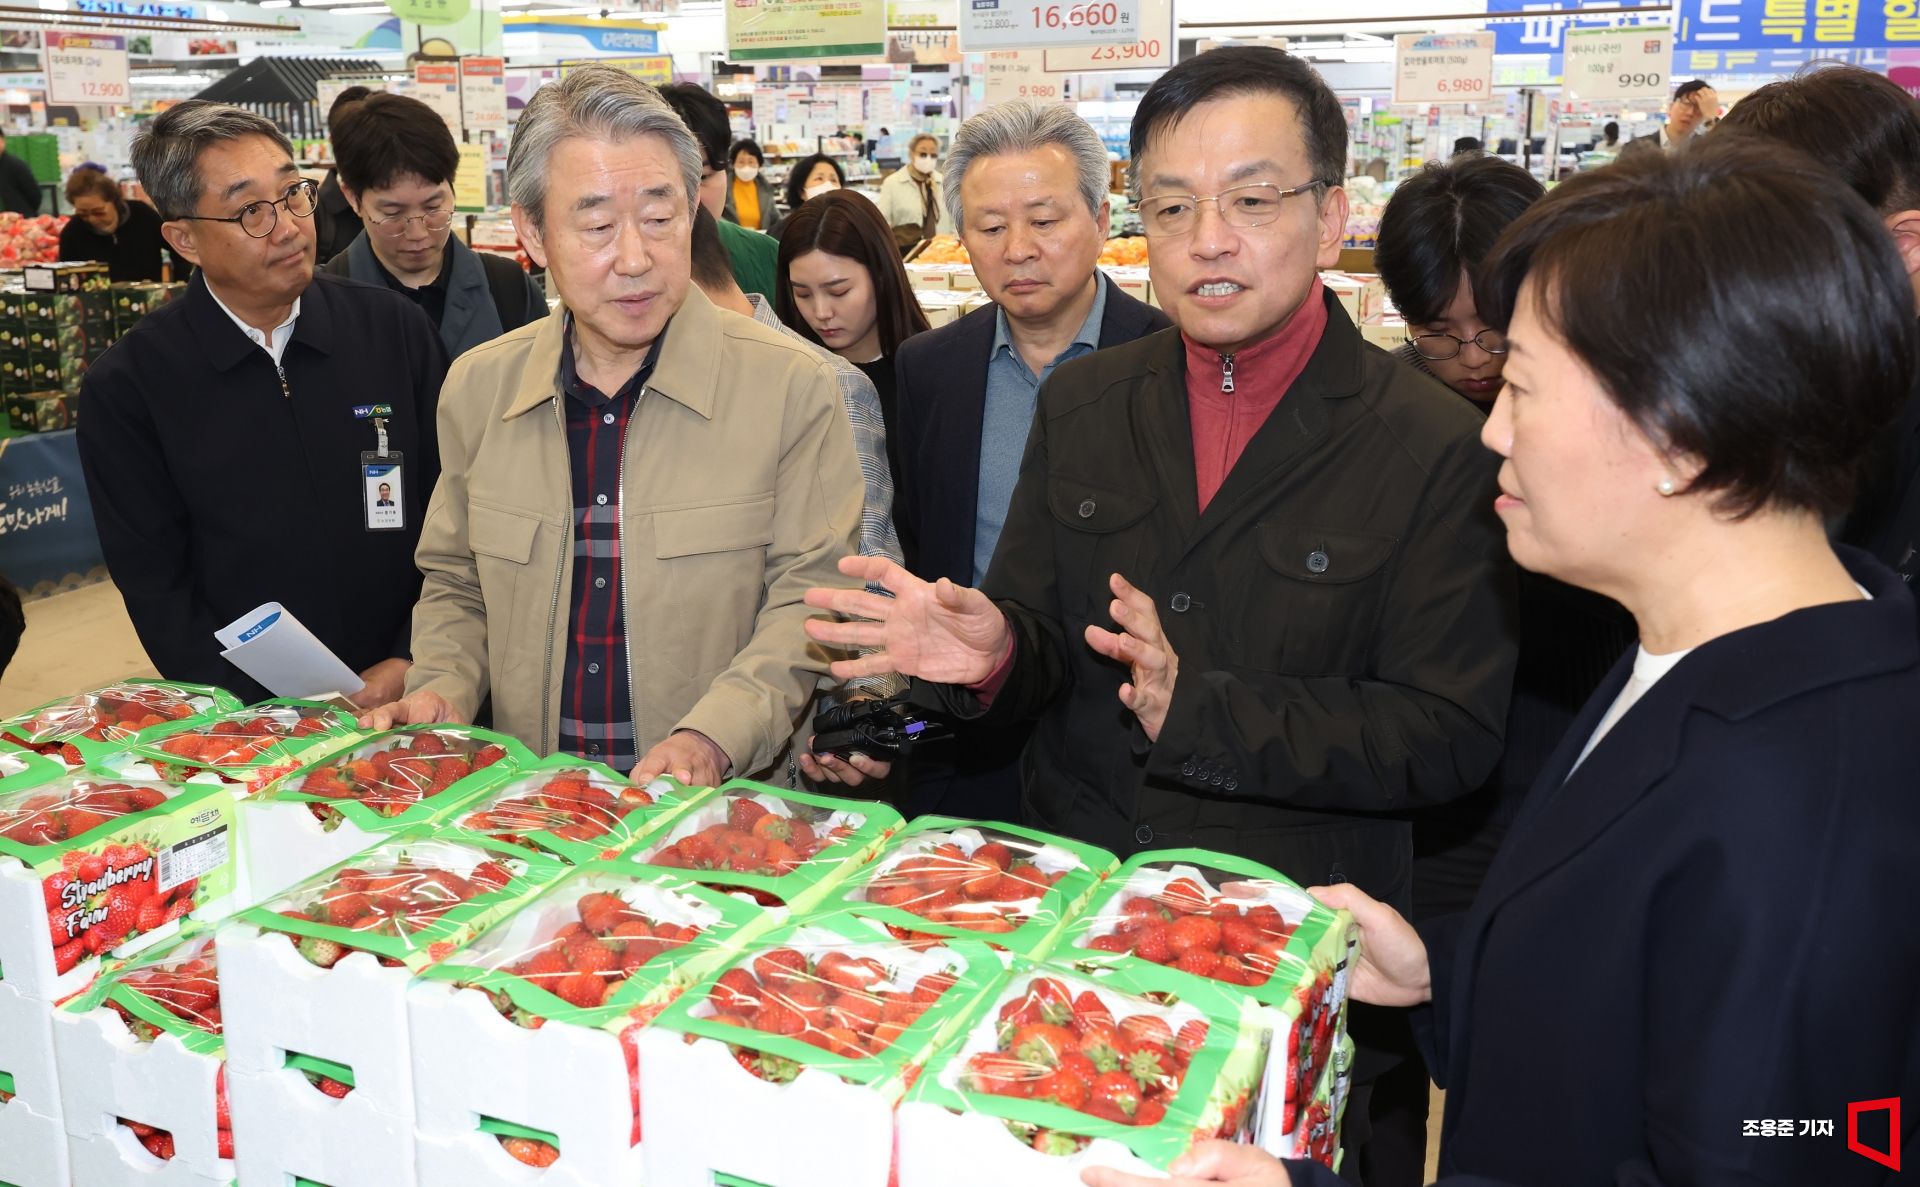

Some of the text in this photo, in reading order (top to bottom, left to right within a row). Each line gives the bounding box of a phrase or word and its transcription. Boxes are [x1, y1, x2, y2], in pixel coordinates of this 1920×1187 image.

[1031, 3, 1129, 29] 16,660 원
[1760, 0, 1859, 43] 특별
[1091, 40, 1160, 60] 23,900
[1437, 79, 1483, 94] 6,980
[1618, 72, 1661, 88] 990
[354, 408, 369, 416] NH
[246, 624, 263, 638] NH
[60, 856, 154, 910] Strawberry
[65, 905, 110, 938] Farm
